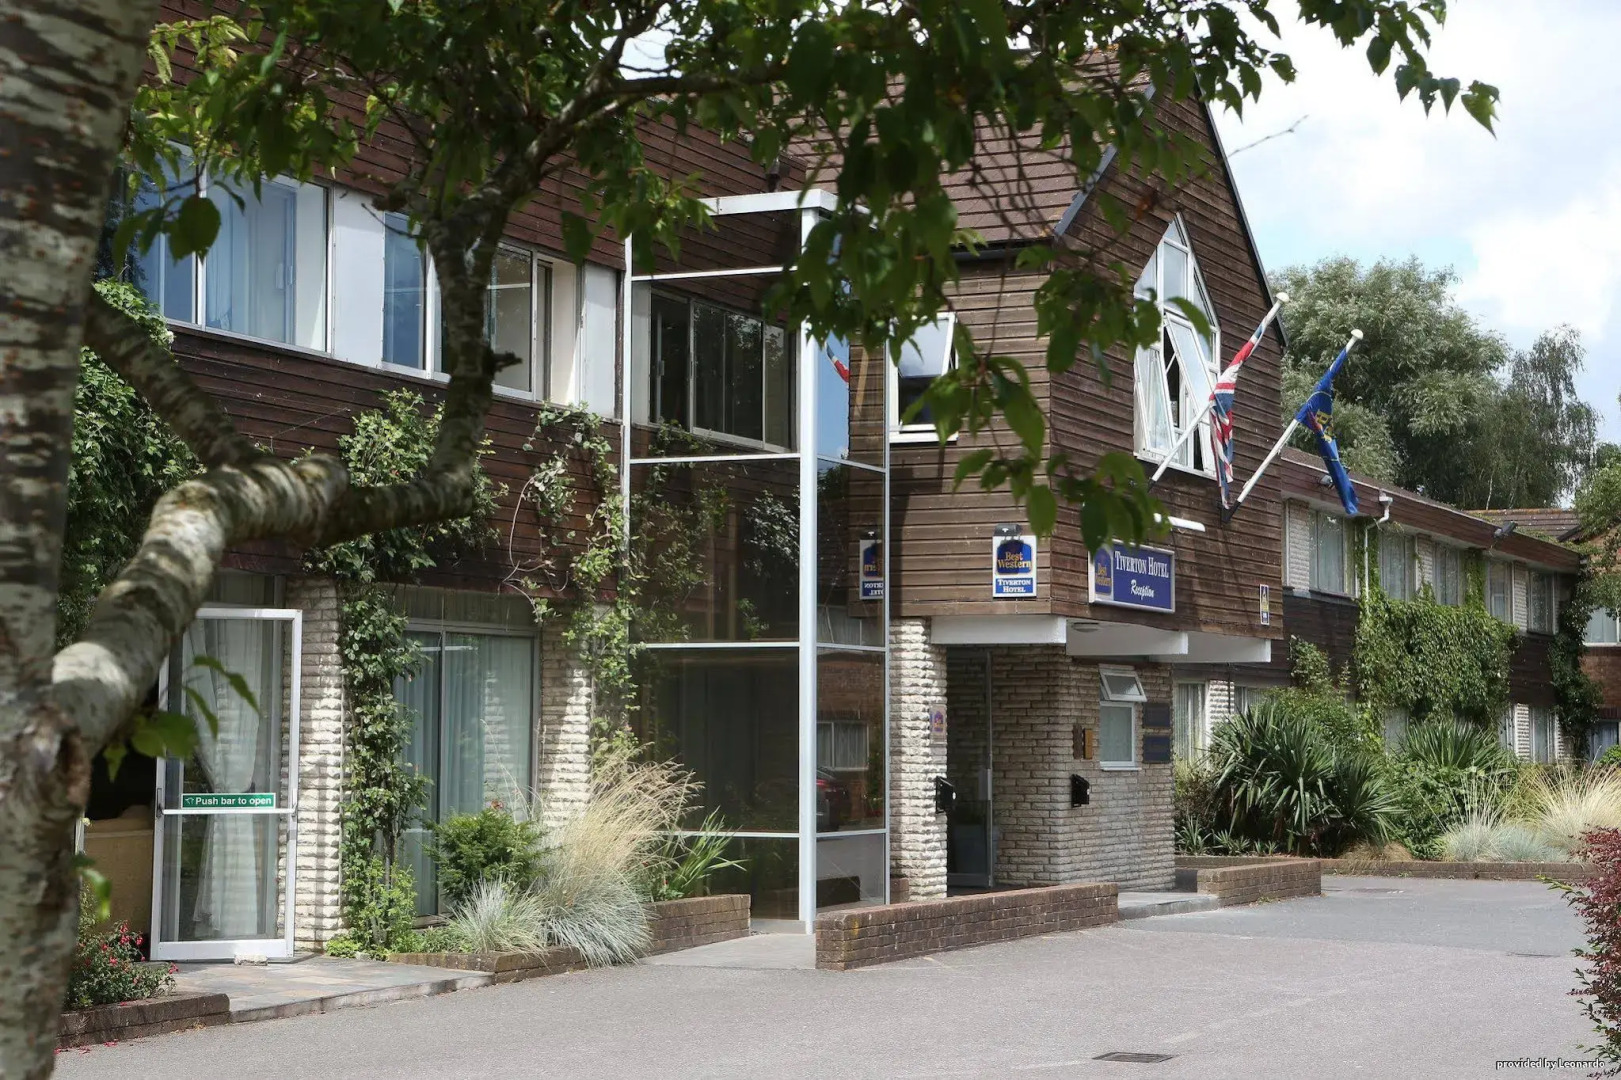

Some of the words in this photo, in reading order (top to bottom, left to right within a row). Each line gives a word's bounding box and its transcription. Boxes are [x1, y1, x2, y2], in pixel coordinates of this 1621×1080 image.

[1005, 551, 1024, 561] Best
[997, 560, 1032, 569] Western
[1114, 550, 1147, 574] TIVERTON
[1148, 556, 1169, 578] HOTEL
[1002, 585, 1026, 593] HOTEL
[1130, 579, 1155, 600] Reception
[195, 797, 218, 805] Push
[221, 797, 236, 805] bar
[238, 797, 247, 805] to
[249, 797, 272, 806] open
